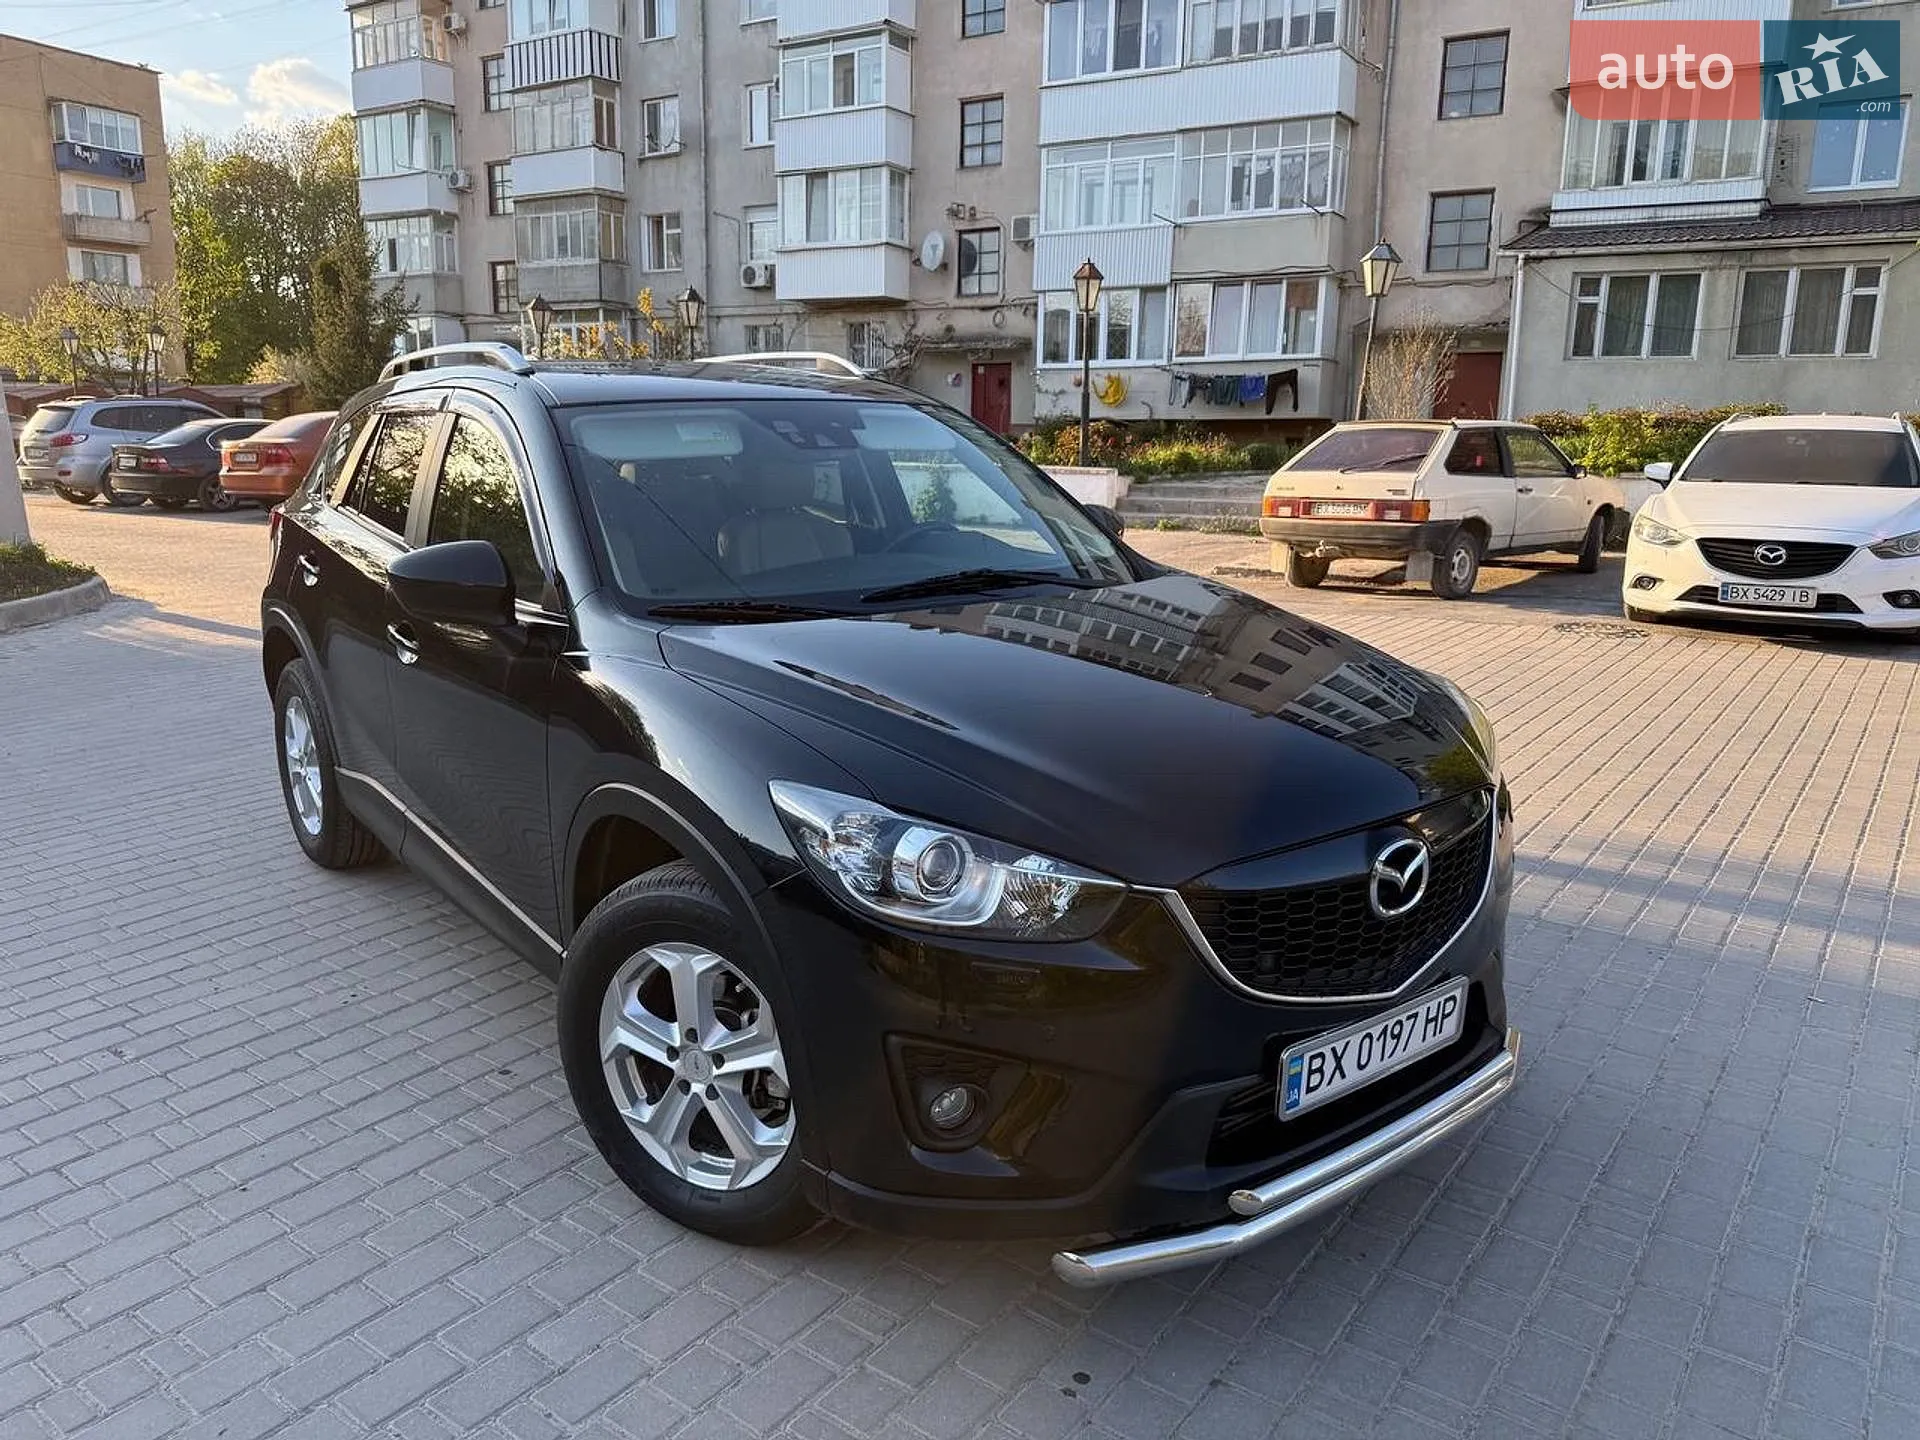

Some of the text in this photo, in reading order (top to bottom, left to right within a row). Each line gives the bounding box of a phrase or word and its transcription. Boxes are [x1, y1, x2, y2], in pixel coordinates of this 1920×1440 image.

[1729, 587, 1750, 600] BX
[1753, 588, 1786, 602] 5429
[1305, 995, 1457, 1095] BX 0197 HP
